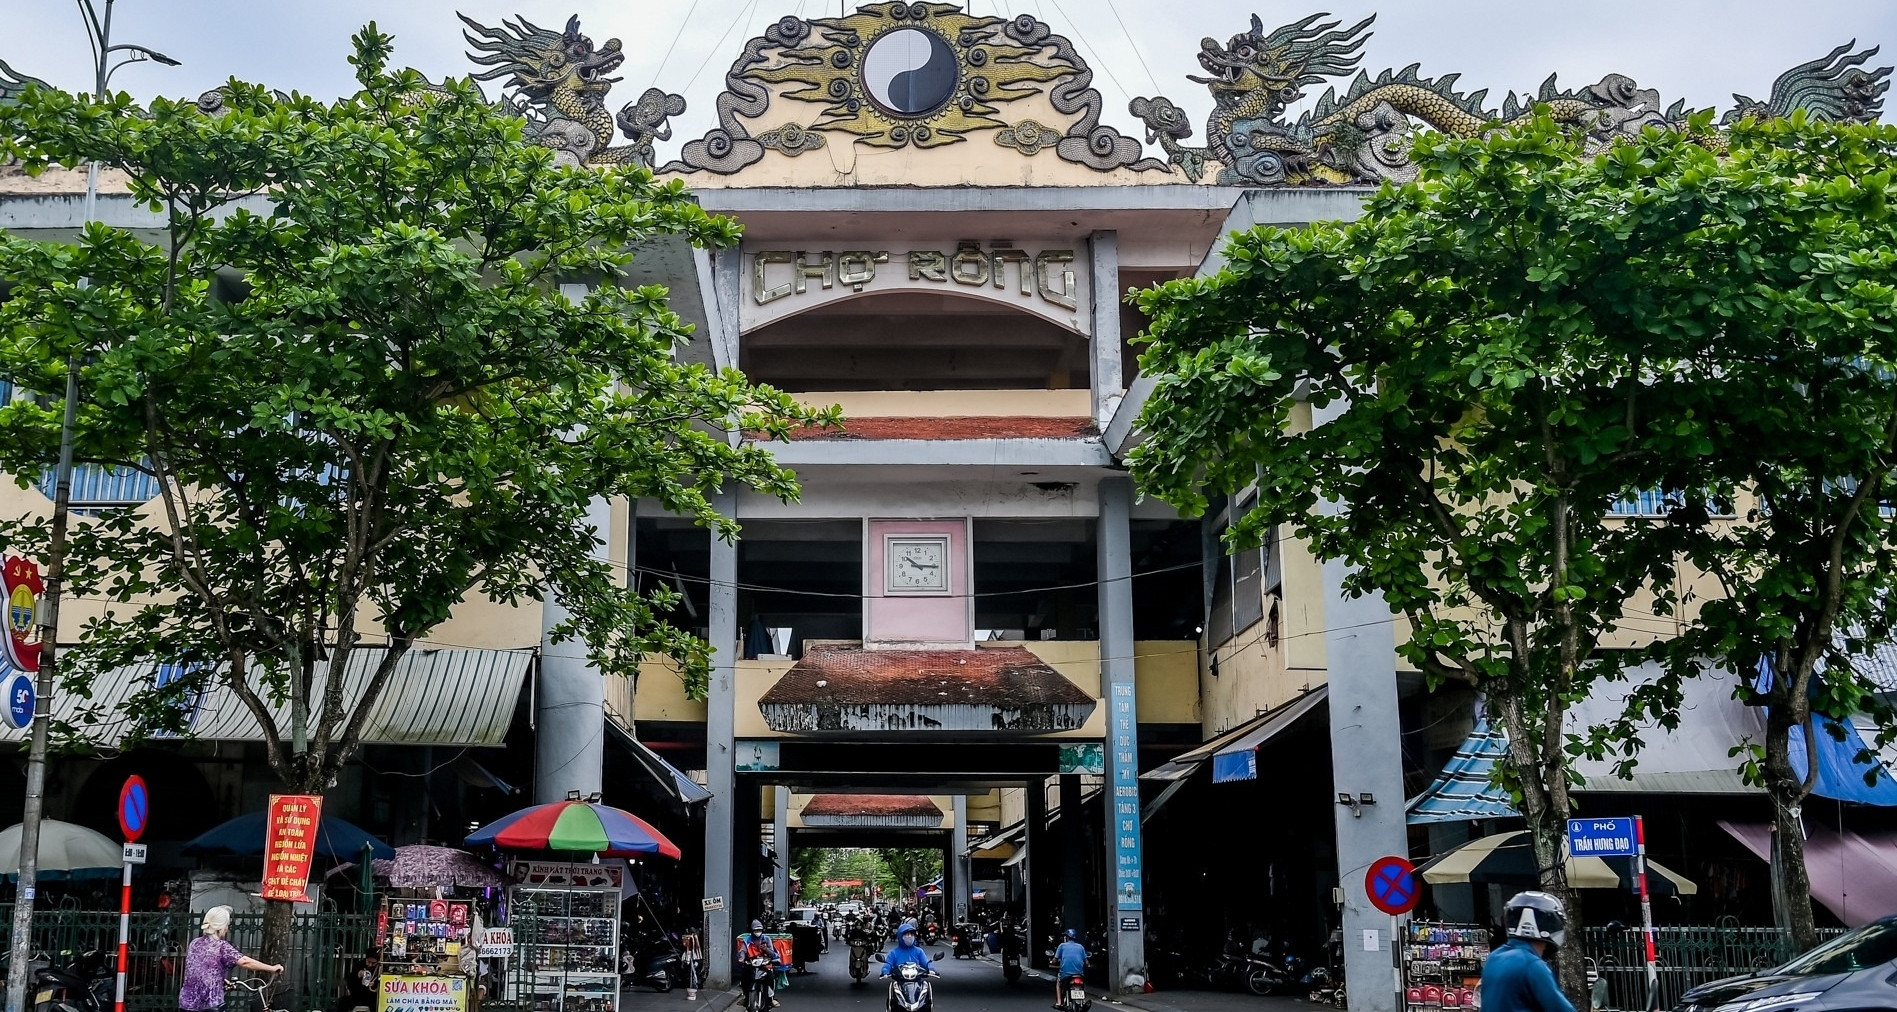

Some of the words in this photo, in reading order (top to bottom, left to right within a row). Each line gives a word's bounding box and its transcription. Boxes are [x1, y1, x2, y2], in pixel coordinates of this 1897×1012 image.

[753, 250, 888, 306] CHỢ
[1115, 686, 1131, 696] TRUNG
[1116, 786, 1137, 796] AEROBIC
[299, 804, 307, 812] LÝ
[1132, 803, 1136, 814] 3
[293, 817, 310, 826] DỤNG
[1593, 820, 1616, 831] PHỐ
[288, 828, 304, 837] TOÀN
[1615, 837, 1629, 851] ĐẠO
[285, 864, 297, 873] CÁC
[289, 877, 305, 886] CHÁY
[491, 929, 512, 944] KHÓA
[384, 978, 407, 993] SỬA
[413, 980, 447, 993] KHÓA
